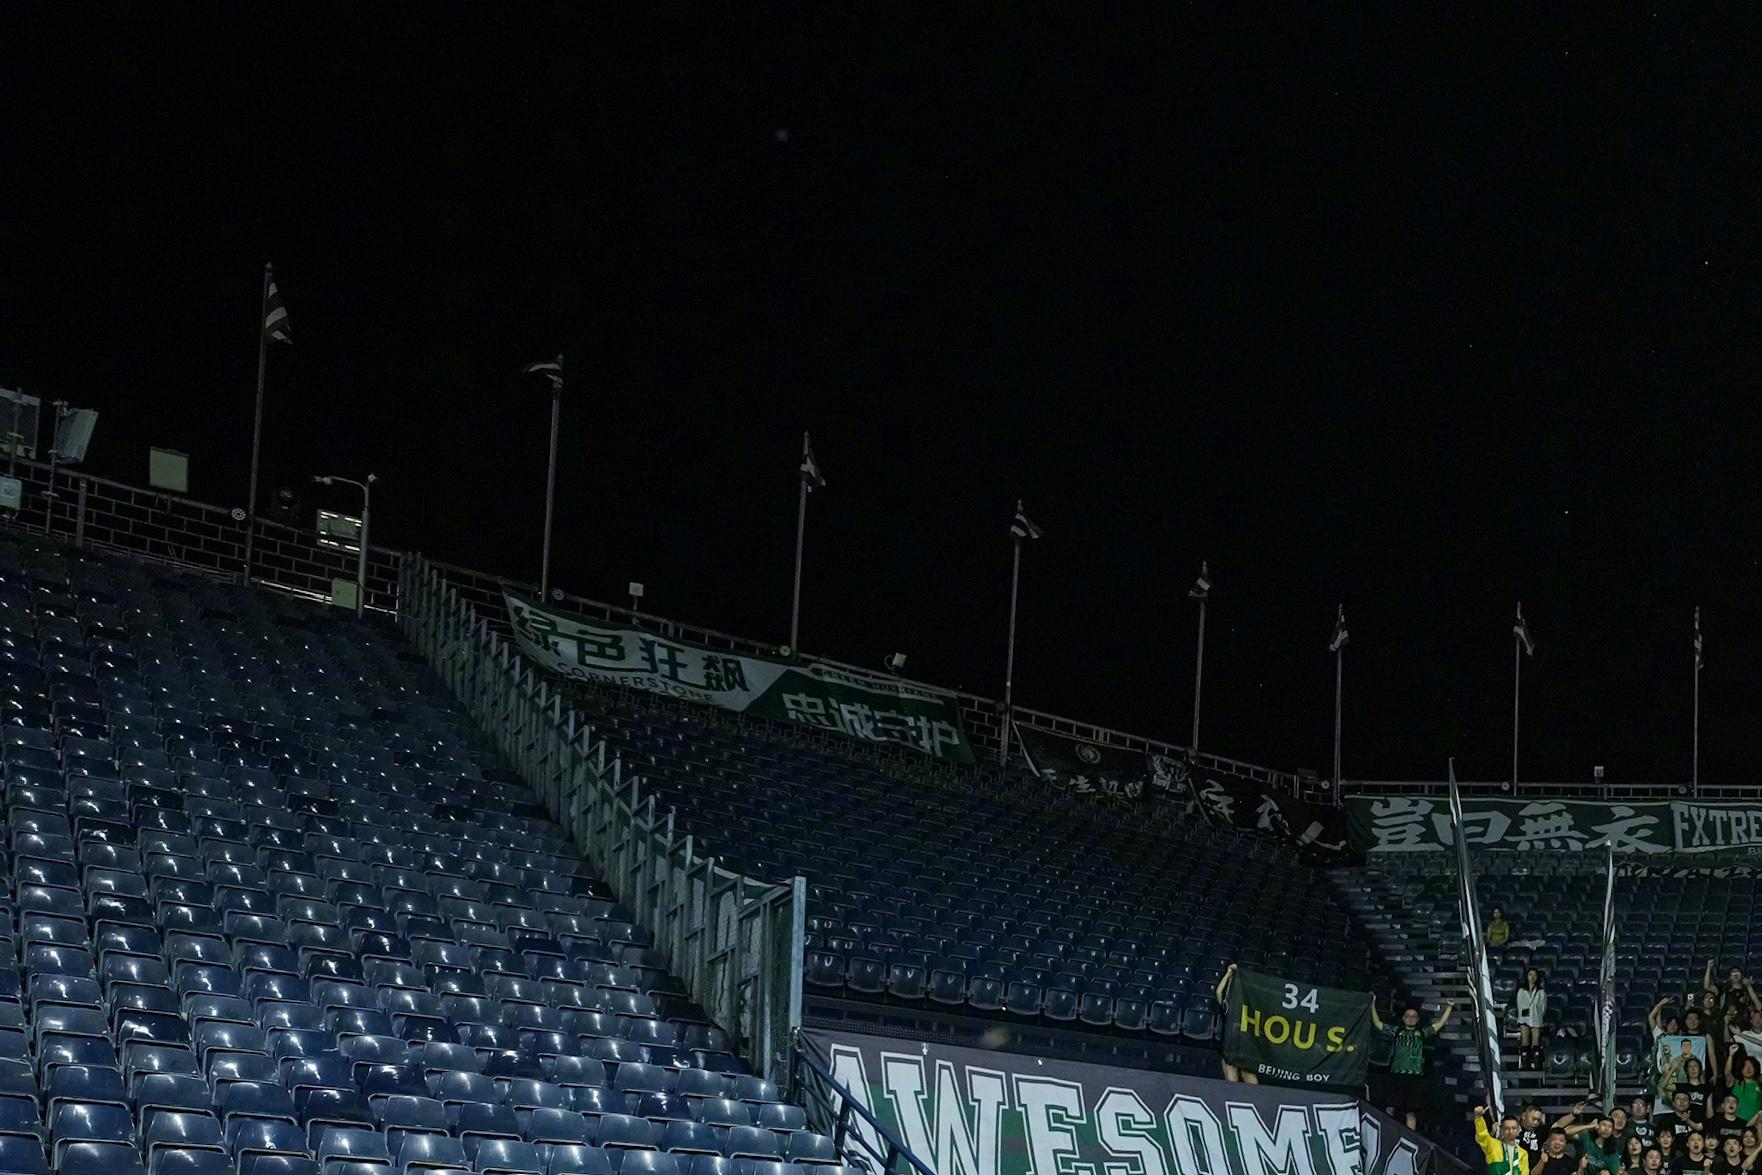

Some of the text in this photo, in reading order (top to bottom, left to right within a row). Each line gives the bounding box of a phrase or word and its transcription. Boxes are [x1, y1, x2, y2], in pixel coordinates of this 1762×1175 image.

[782, 692, 961, 758] 忠诚守护
[1282, 983, 1320, 1013] 34
[1240, 1004, 1355, 1052] HOU S.
[1258, 1063, 1330, 1082] BEIJING BOY
